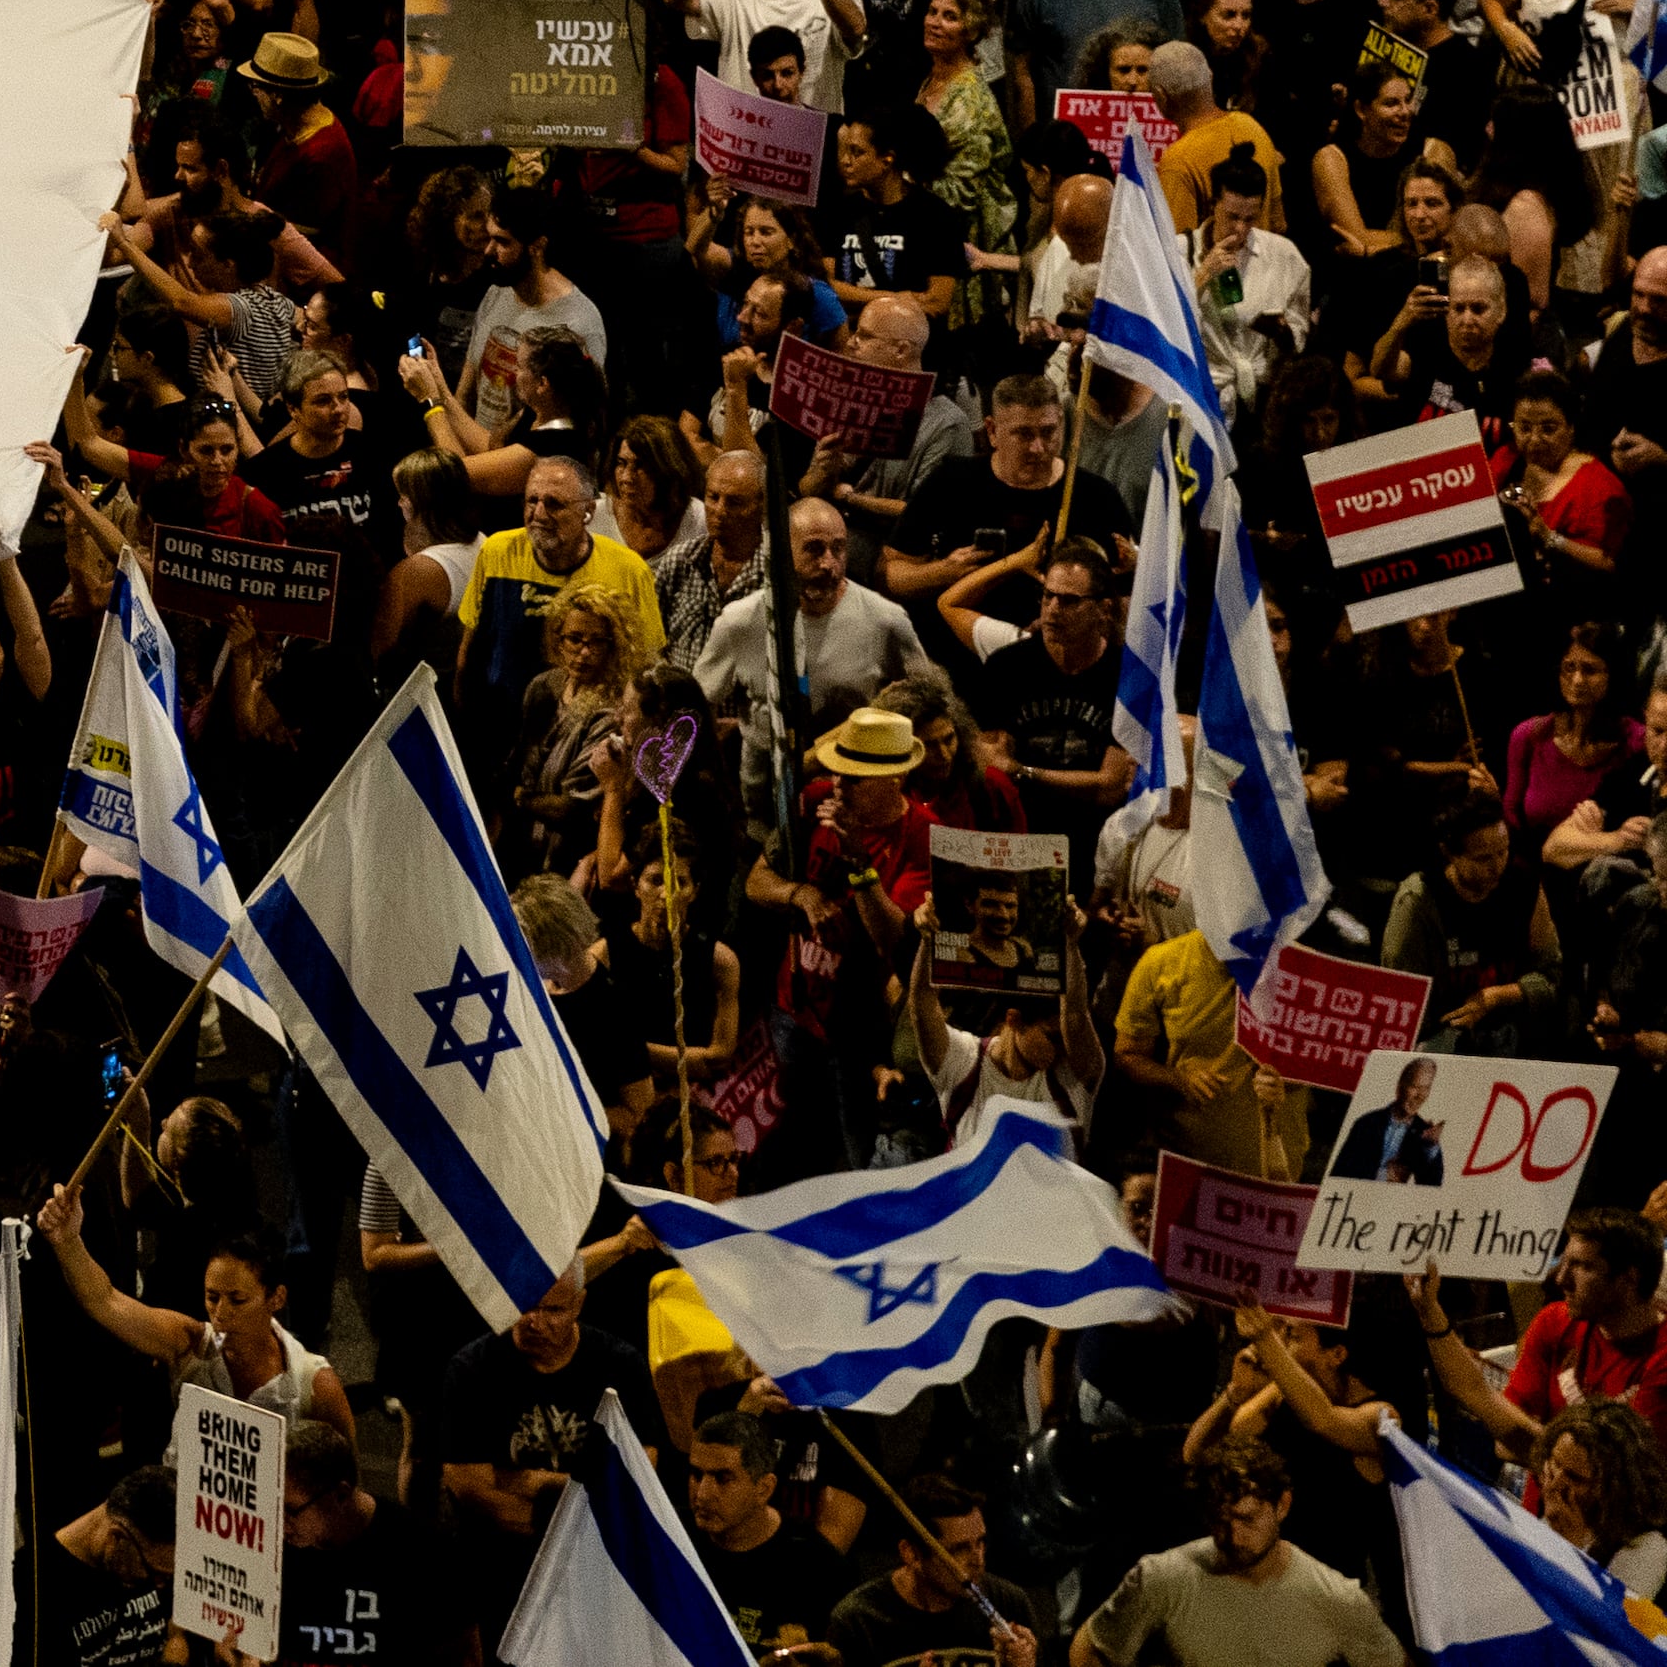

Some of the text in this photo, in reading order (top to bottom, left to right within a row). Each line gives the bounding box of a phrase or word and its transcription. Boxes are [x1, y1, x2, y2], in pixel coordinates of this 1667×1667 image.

[547, 42, 613, 67] אמא
[509, 67, 618, 96] מחליטה
[1557, 77, 1618, 121] ROM
[1065, 98, 1104, 116] את
[763, 143, 812, 168] נשים
[1335, 463, 1478, 520] עסקה עכשיו
[164, 537, 330, 581] OUR SISTERS ARE
[1360, 538, 1496, 594] נגמר הזמן
[157, 559, 332, 604] CALLING FOR HELP
[1372, 997, 1417, 1027] זה
[1462, 1083, 1599, 1184] DO
[1214, 1196, 1298, 1238] חיים
[1319, 1189, 1461, 1264] The right
[1181, 1242, 1318, 1299] או מוות
[196, 1409, 262, 1454] BRING
[199, 1434, 258, 1478] THEM
[197, 1466, 257, 1512] HOME
[194, 1495, 265, 1554] NOW!
[200, 1552, 249, 1585] תחזירו
[183, 1569, 265, 1621] אותם הביתה
[345, 1588, 381, 1624] בן
[299, 1624, 376, 1655] גביר
